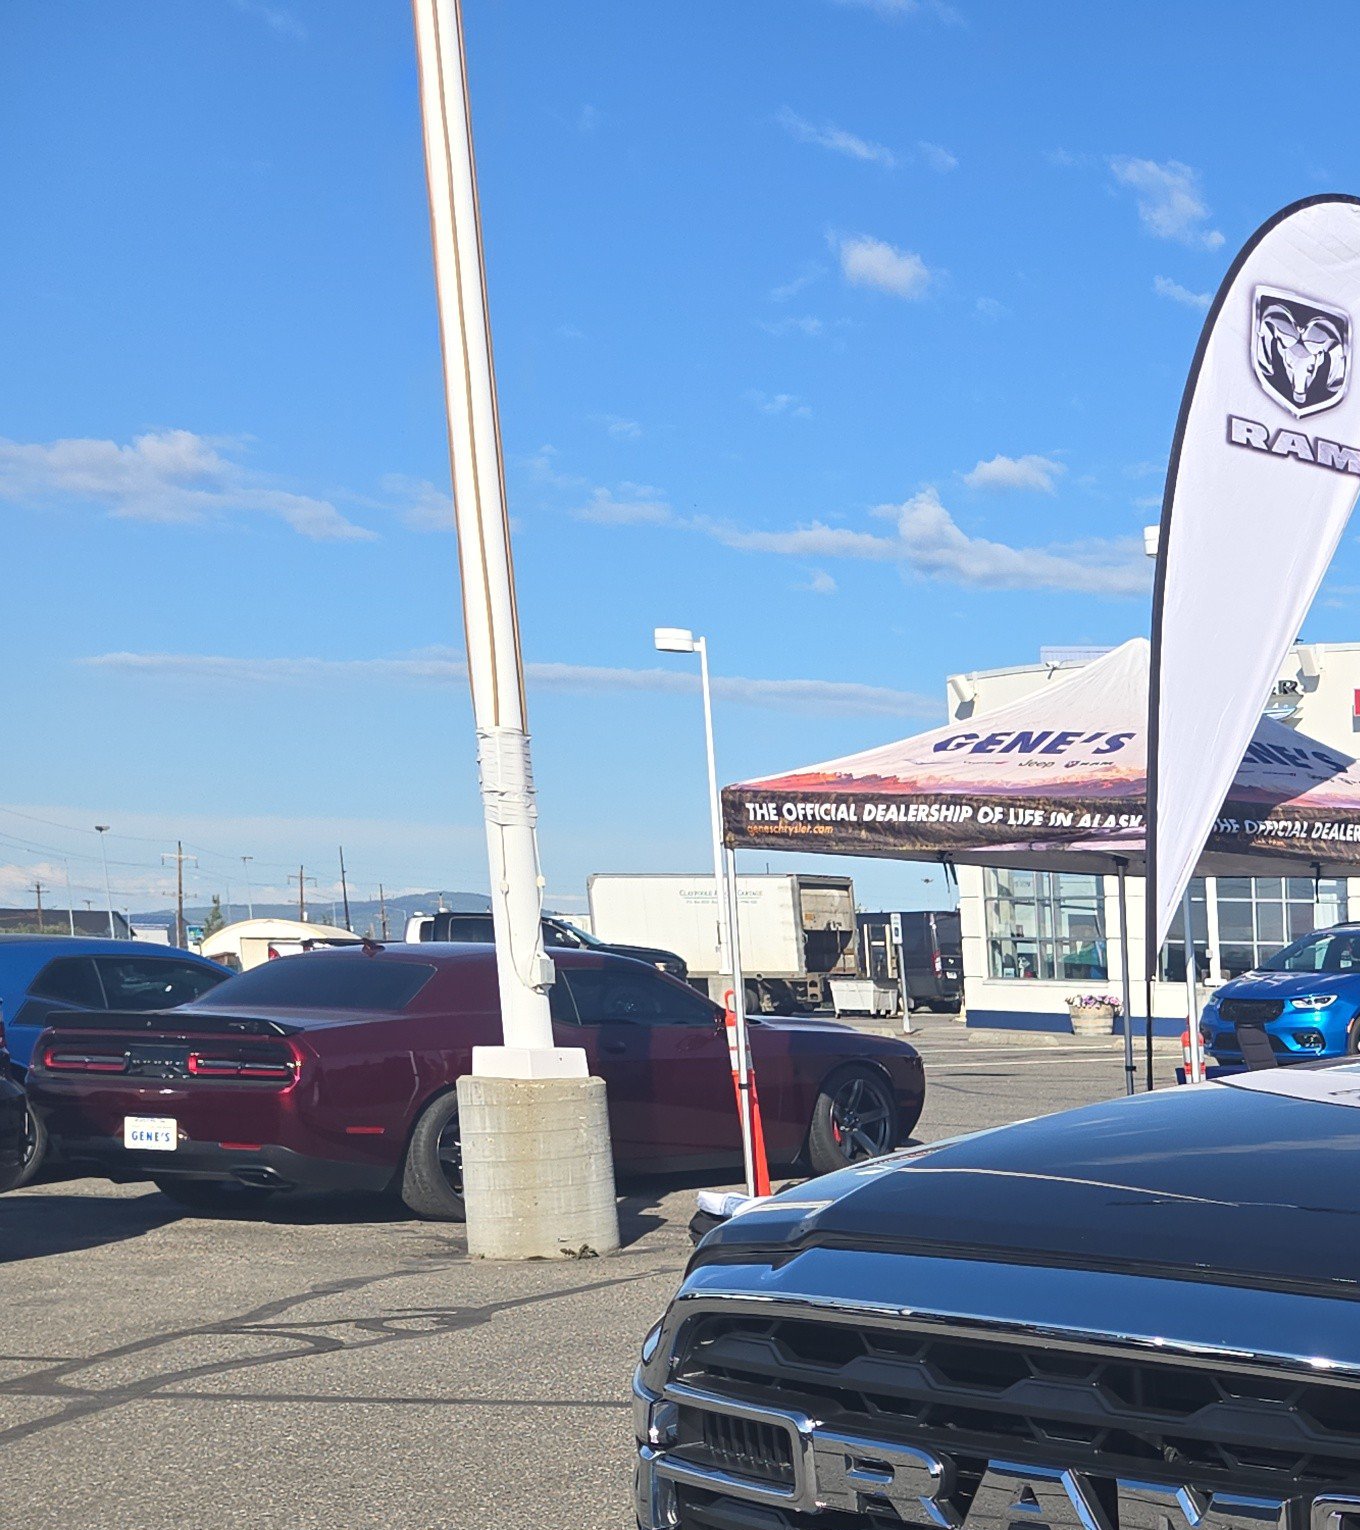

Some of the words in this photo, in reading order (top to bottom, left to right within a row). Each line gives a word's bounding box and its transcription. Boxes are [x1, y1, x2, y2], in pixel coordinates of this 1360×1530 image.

[933, 731, 1137, 754] GENE'S
[1018, 758, 1056, 769] Jeep
[745, 803, 779, 821] THE
[783, 803, 858, 822] OFFICIAL
[863, 804, 973, 824] DEALERSHIP
[977, 807, 1004, 824] OF
[1007, 808, 1045, 826] LIFE
[1049, 811, 1074, 827] IN
[1076, 813, 1146, 828] ALASK
[747, 822, 834, 837] geneschrysler.com
[1245, 820, 1308, 838] OFFICIAL
[131, 1130, 171, 1142] GENE'S
